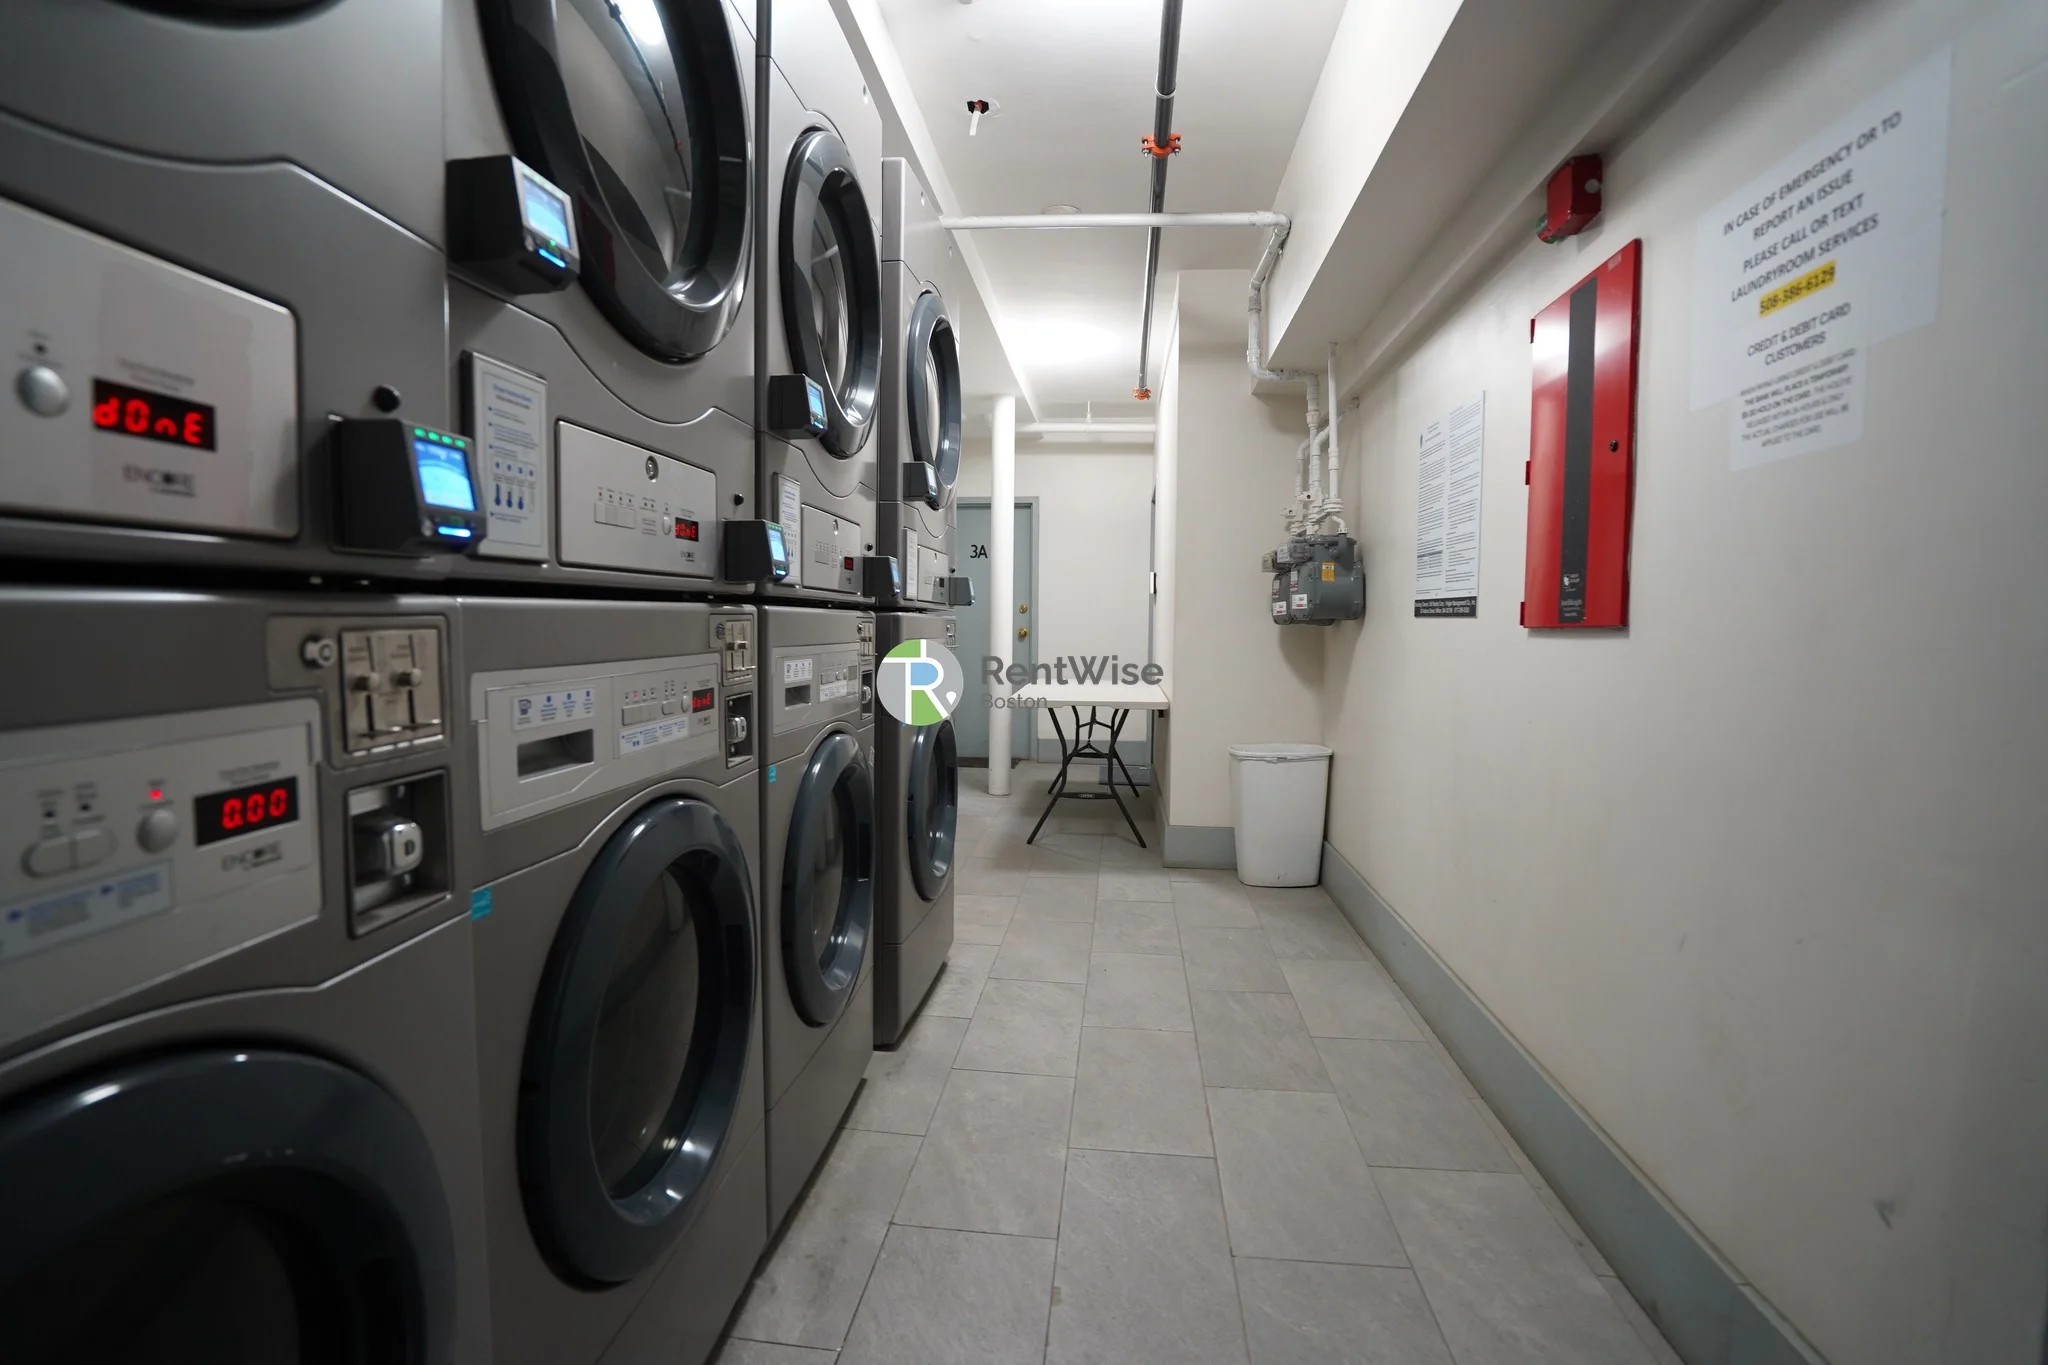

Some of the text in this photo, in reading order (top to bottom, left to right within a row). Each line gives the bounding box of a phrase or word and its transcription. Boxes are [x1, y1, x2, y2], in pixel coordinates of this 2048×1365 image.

[1724, 110, 1902, 236] IN CASE OF EMERGENCY OR TO
[1753, 168, 1853, 241] REPORT AN ISSUE
[1731, 212, 1879, 302] LAUNDRYROOM SERVICES
[1743, 192, 1864, 273] PLEASE CALL OR TEXT
[1747, 302, 1851, 357] CREDIT & DEBIT CARD
[1764, 331, 1826, 366] CUSTOMERS
[970, 544, 988, 559] 3A
